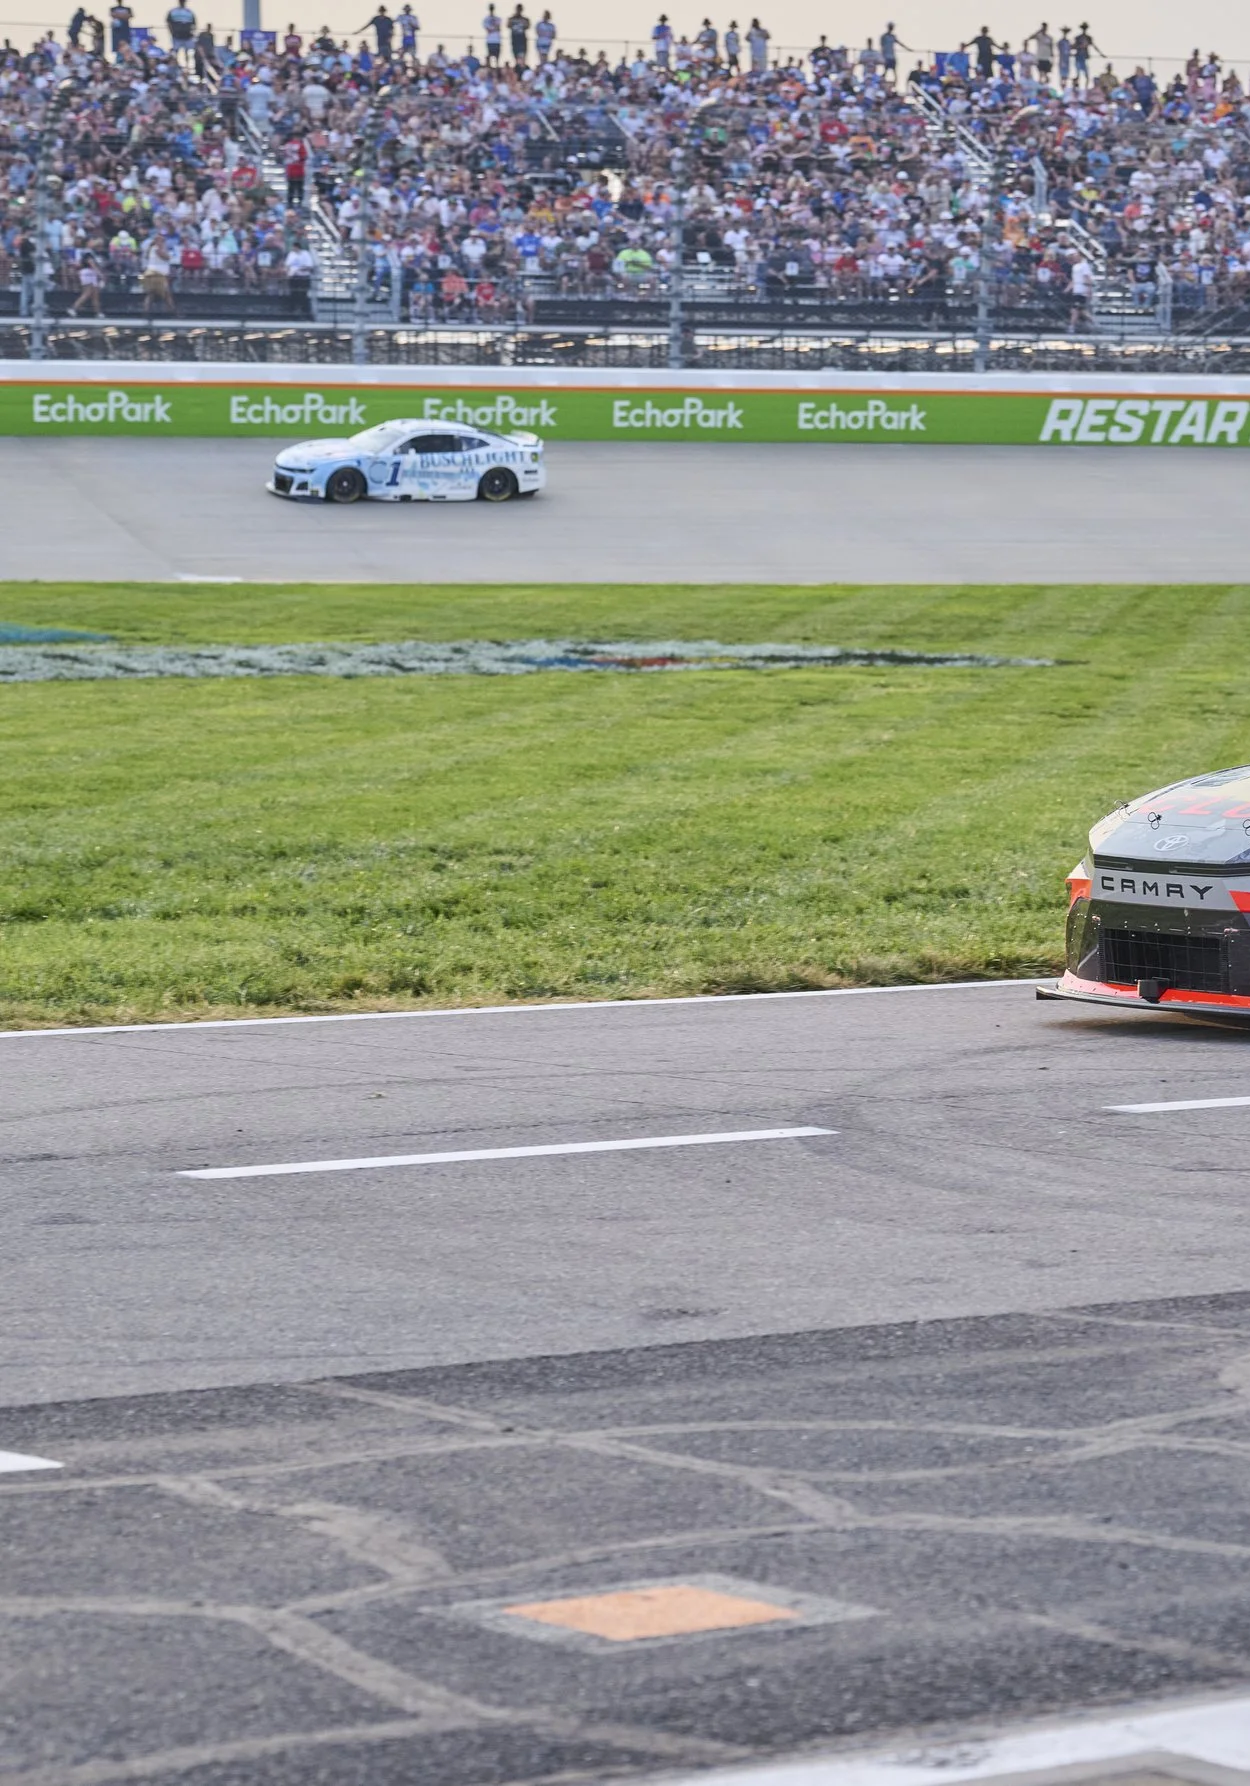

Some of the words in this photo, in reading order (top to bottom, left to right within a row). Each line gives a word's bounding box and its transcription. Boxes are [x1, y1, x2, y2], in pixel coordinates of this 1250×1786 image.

[33, 391, 172, 423] EchoPark
[230, 393, 366, 425] EchoPark
[423, 396, 557, 426] EchoPark
[612, 398, 743, 428] EchoPark
[798, 400, 926, 430] EchoPark
[386, 462, 401, 486] 1
[420, 453, 473, 469] BUSCH
[475, 450, 526, 465] LIGHT
[1101, 876, 1213, 900] CAMRY
